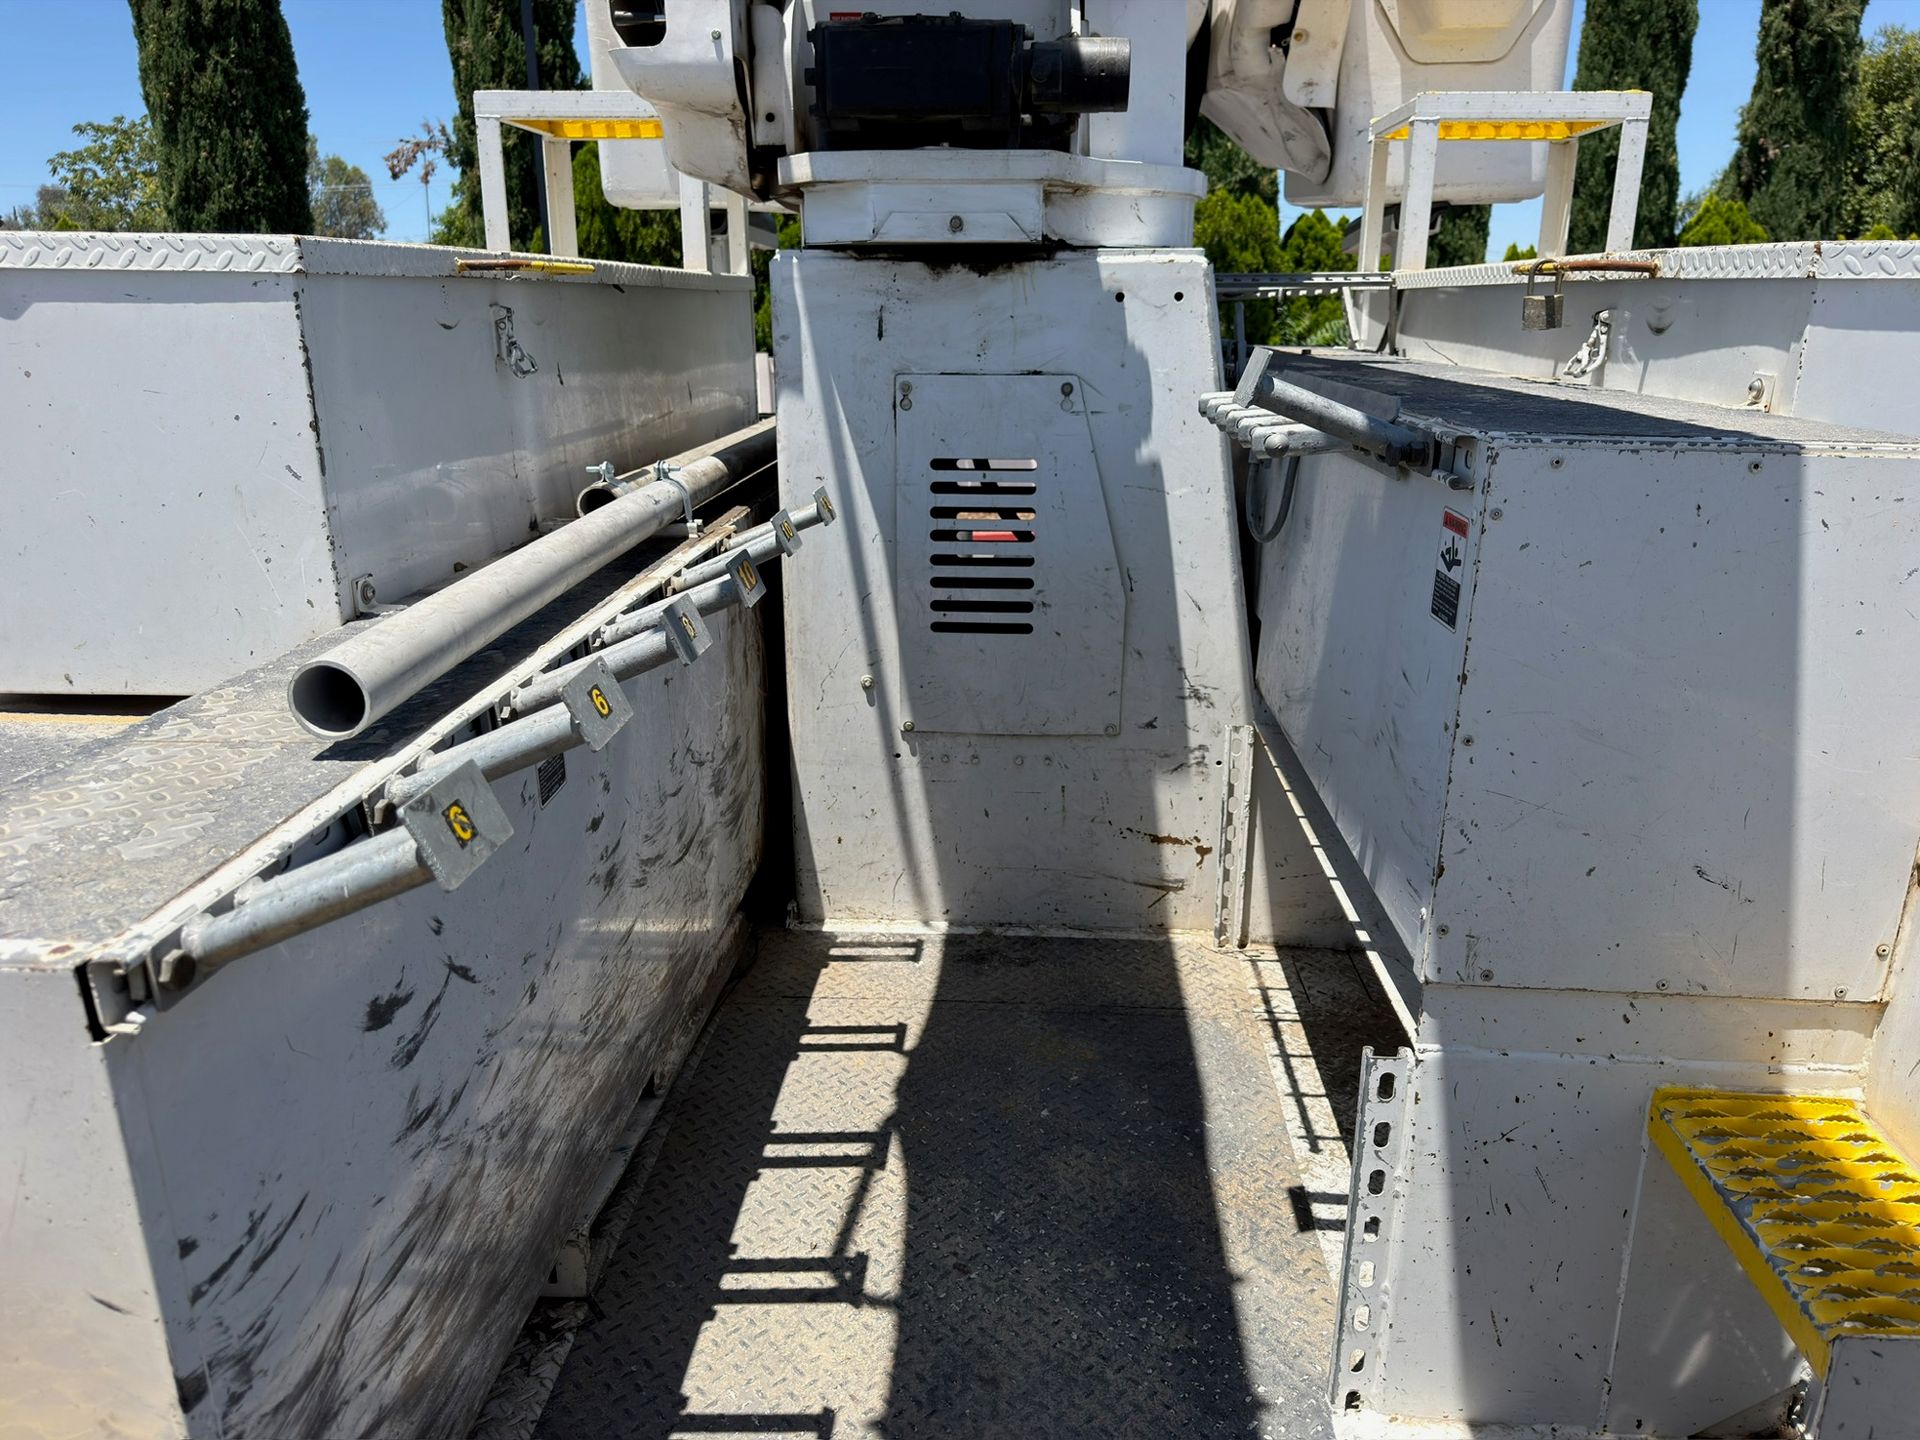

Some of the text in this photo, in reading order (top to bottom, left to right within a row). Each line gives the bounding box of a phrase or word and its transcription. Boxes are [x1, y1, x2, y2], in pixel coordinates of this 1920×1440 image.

[781, 521, 793, 538] 10
[738, 559, 756, 589] 10
[591, 688, 609, 715] 6
[449, 805, 472, 840] 6
